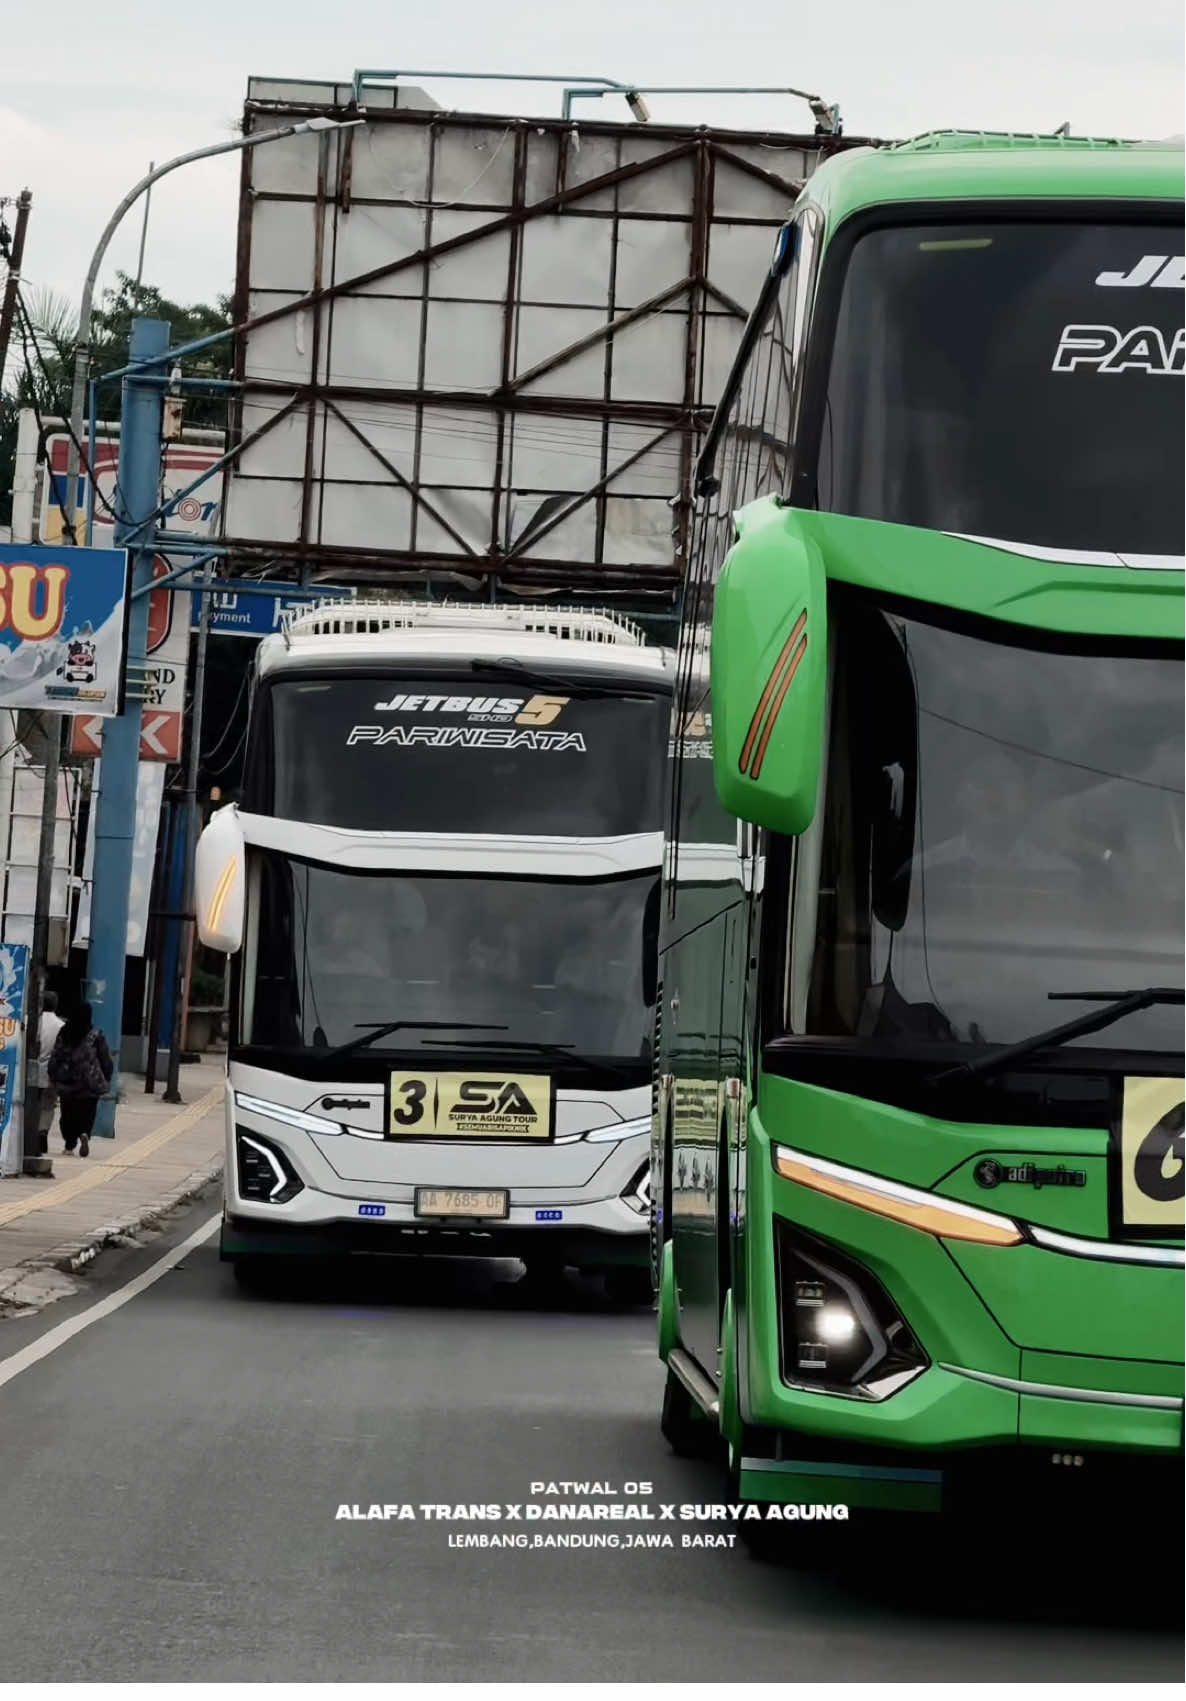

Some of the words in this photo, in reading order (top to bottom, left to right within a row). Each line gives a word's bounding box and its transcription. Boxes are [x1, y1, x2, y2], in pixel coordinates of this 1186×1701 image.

[1051, 324, 1185, 375] PA
[374, 694, 525, 714] JETBUS
[514, 693, 571, 726] 5
[346, 726, 588, 752] PARIWISATA
[394, 1080, 427, 1126] 3
[480, 1115, 512, 1123] AGUNG
[514, 1116, 538, 1124] TOUR
[445, 1192, 480, 1208] 7685
